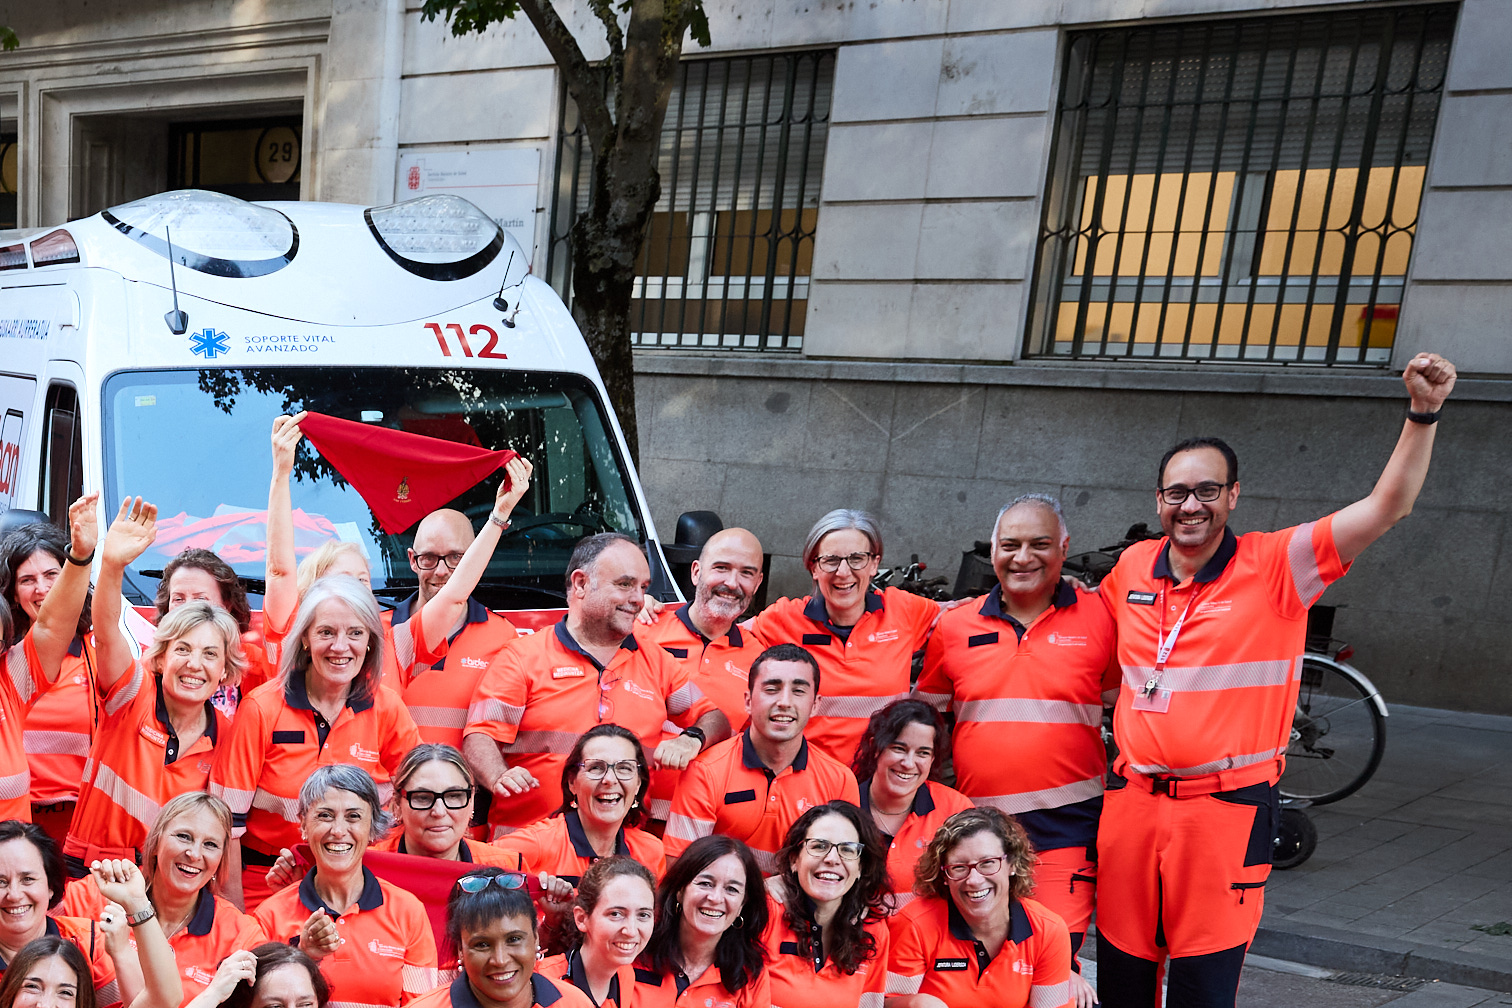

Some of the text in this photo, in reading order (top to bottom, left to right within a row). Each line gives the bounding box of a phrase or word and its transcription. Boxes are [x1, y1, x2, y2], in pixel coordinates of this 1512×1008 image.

[268, 142, 292, 163] 29
[244, 335, 336, 344] SOPORTE VITAL
[424, 323, 508, 360] 112
[246, 344, 319, 353] AVANZADO
